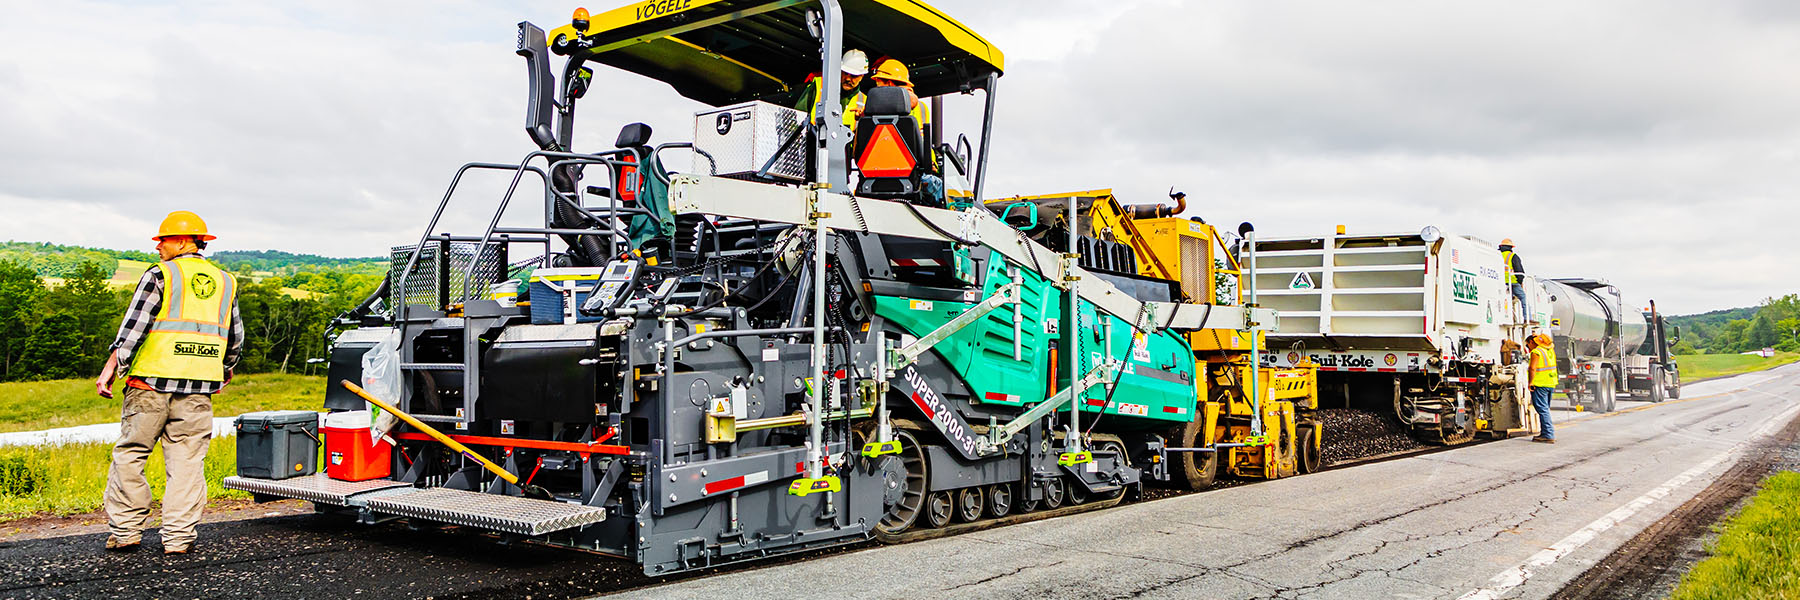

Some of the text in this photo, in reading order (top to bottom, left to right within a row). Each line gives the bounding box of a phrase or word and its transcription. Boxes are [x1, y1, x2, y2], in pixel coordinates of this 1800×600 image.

[636, 0, 691, 20] VÖGELE
[1310, 354, 1374, 368] Suit-Kote
[904, 365, 976, 456] SUPER 2000-3i
